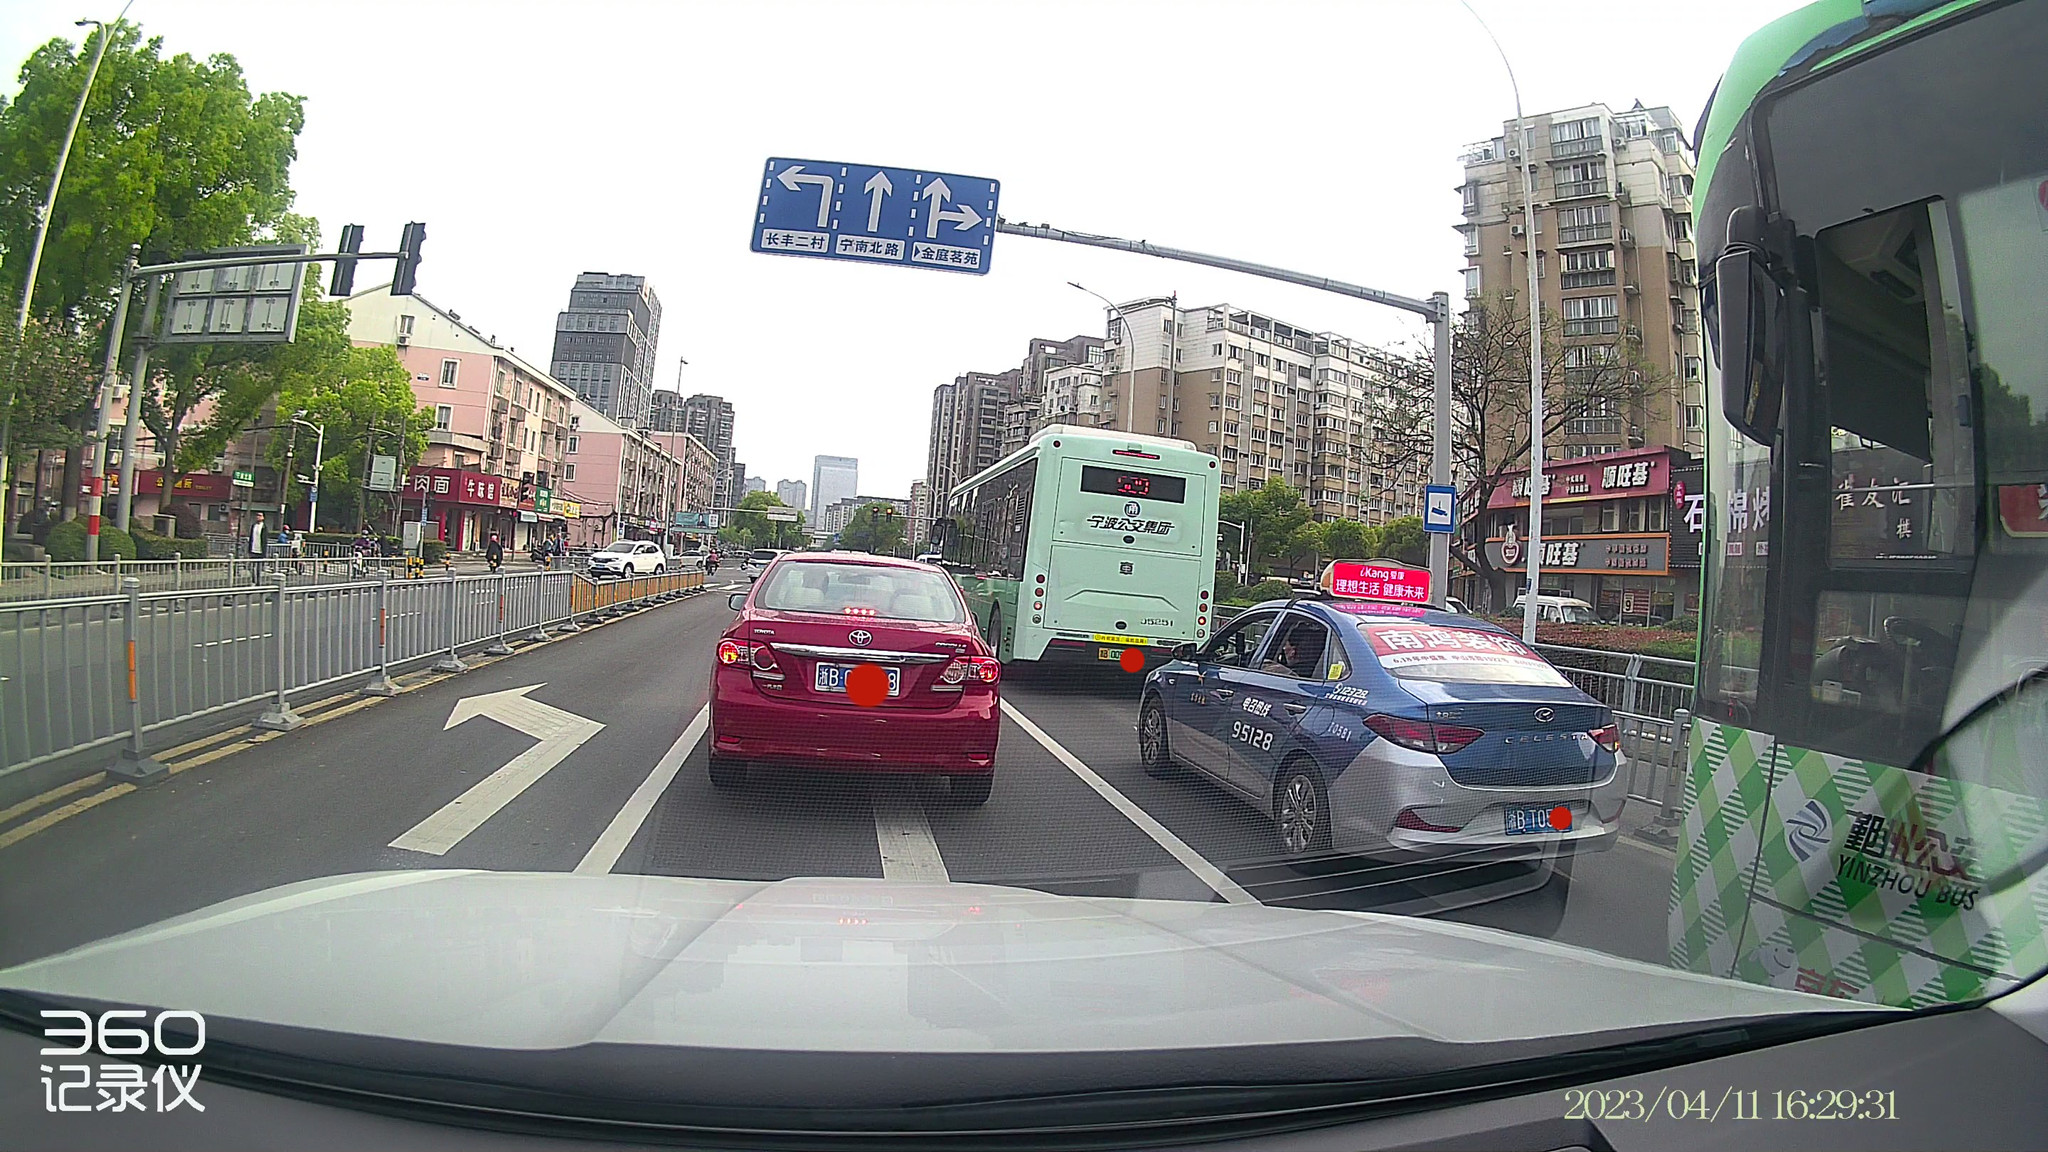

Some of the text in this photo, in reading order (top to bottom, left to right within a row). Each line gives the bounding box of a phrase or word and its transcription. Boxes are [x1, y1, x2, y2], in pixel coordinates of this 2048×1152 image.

[766, 231, 826, 250] 长丰二村
[839, 238, 899, 257] 宁南北路
[921, 246, 979, 266] 金庭茗苑
[1601, 461, 1649, 489] 顺旺基
[1086, 515, 1176, 536] 宁波公交集团
[1360, 565, 1389, 581] iKang
[1335, 579, 1425, 599] 理想生活 健康未来
[1374, 628, 1527, 656] 南鸿装饰
[1231, 720, 1274, 752] 95128
[1505, 732, 1589, 745] CELESTA
[1837, 853, 1980, 911] YINZHOU BUS
